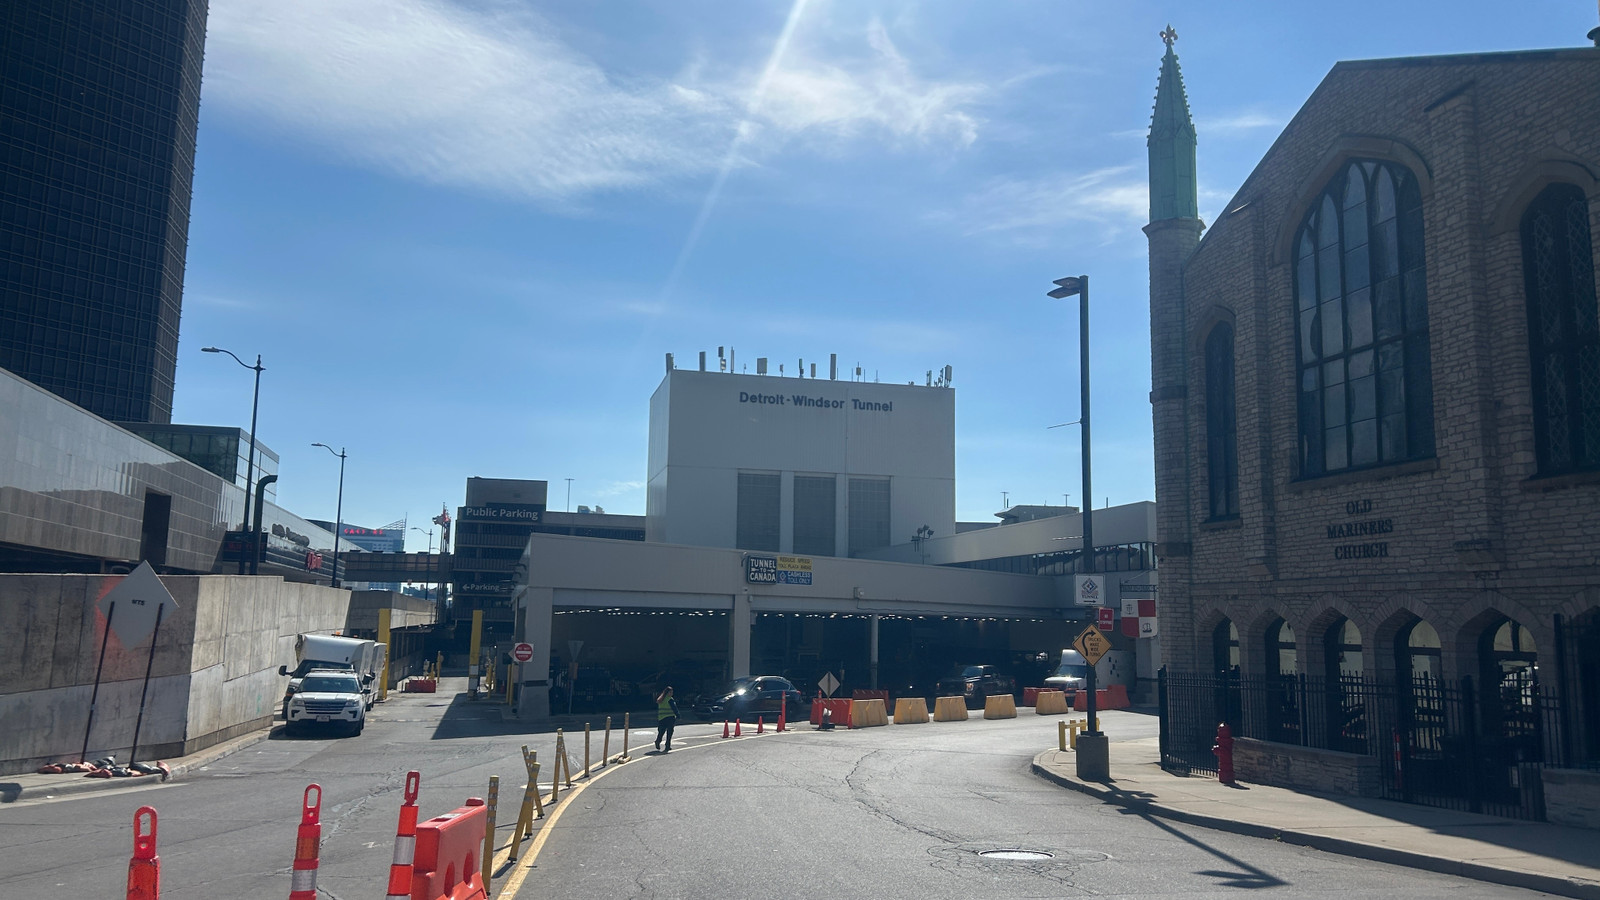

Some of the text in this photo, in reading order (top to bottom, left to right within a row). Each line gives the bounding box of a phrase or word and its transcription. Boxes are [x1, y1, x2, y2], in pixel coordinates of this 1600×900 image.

[852, 398, 893, 412] Tunnel
[466, 507, 539, 521] Public Parking
[1346, 499, 1372, 515] OLD
[1327, 519, 1393, 538] MARINERS
[1335, 542, 1389, 560] CHURCH
[751, 558, 776, 569] TUNNEL
[750, 572, 776, 582] CANADA
[470, 583, 500, 592] Parking
